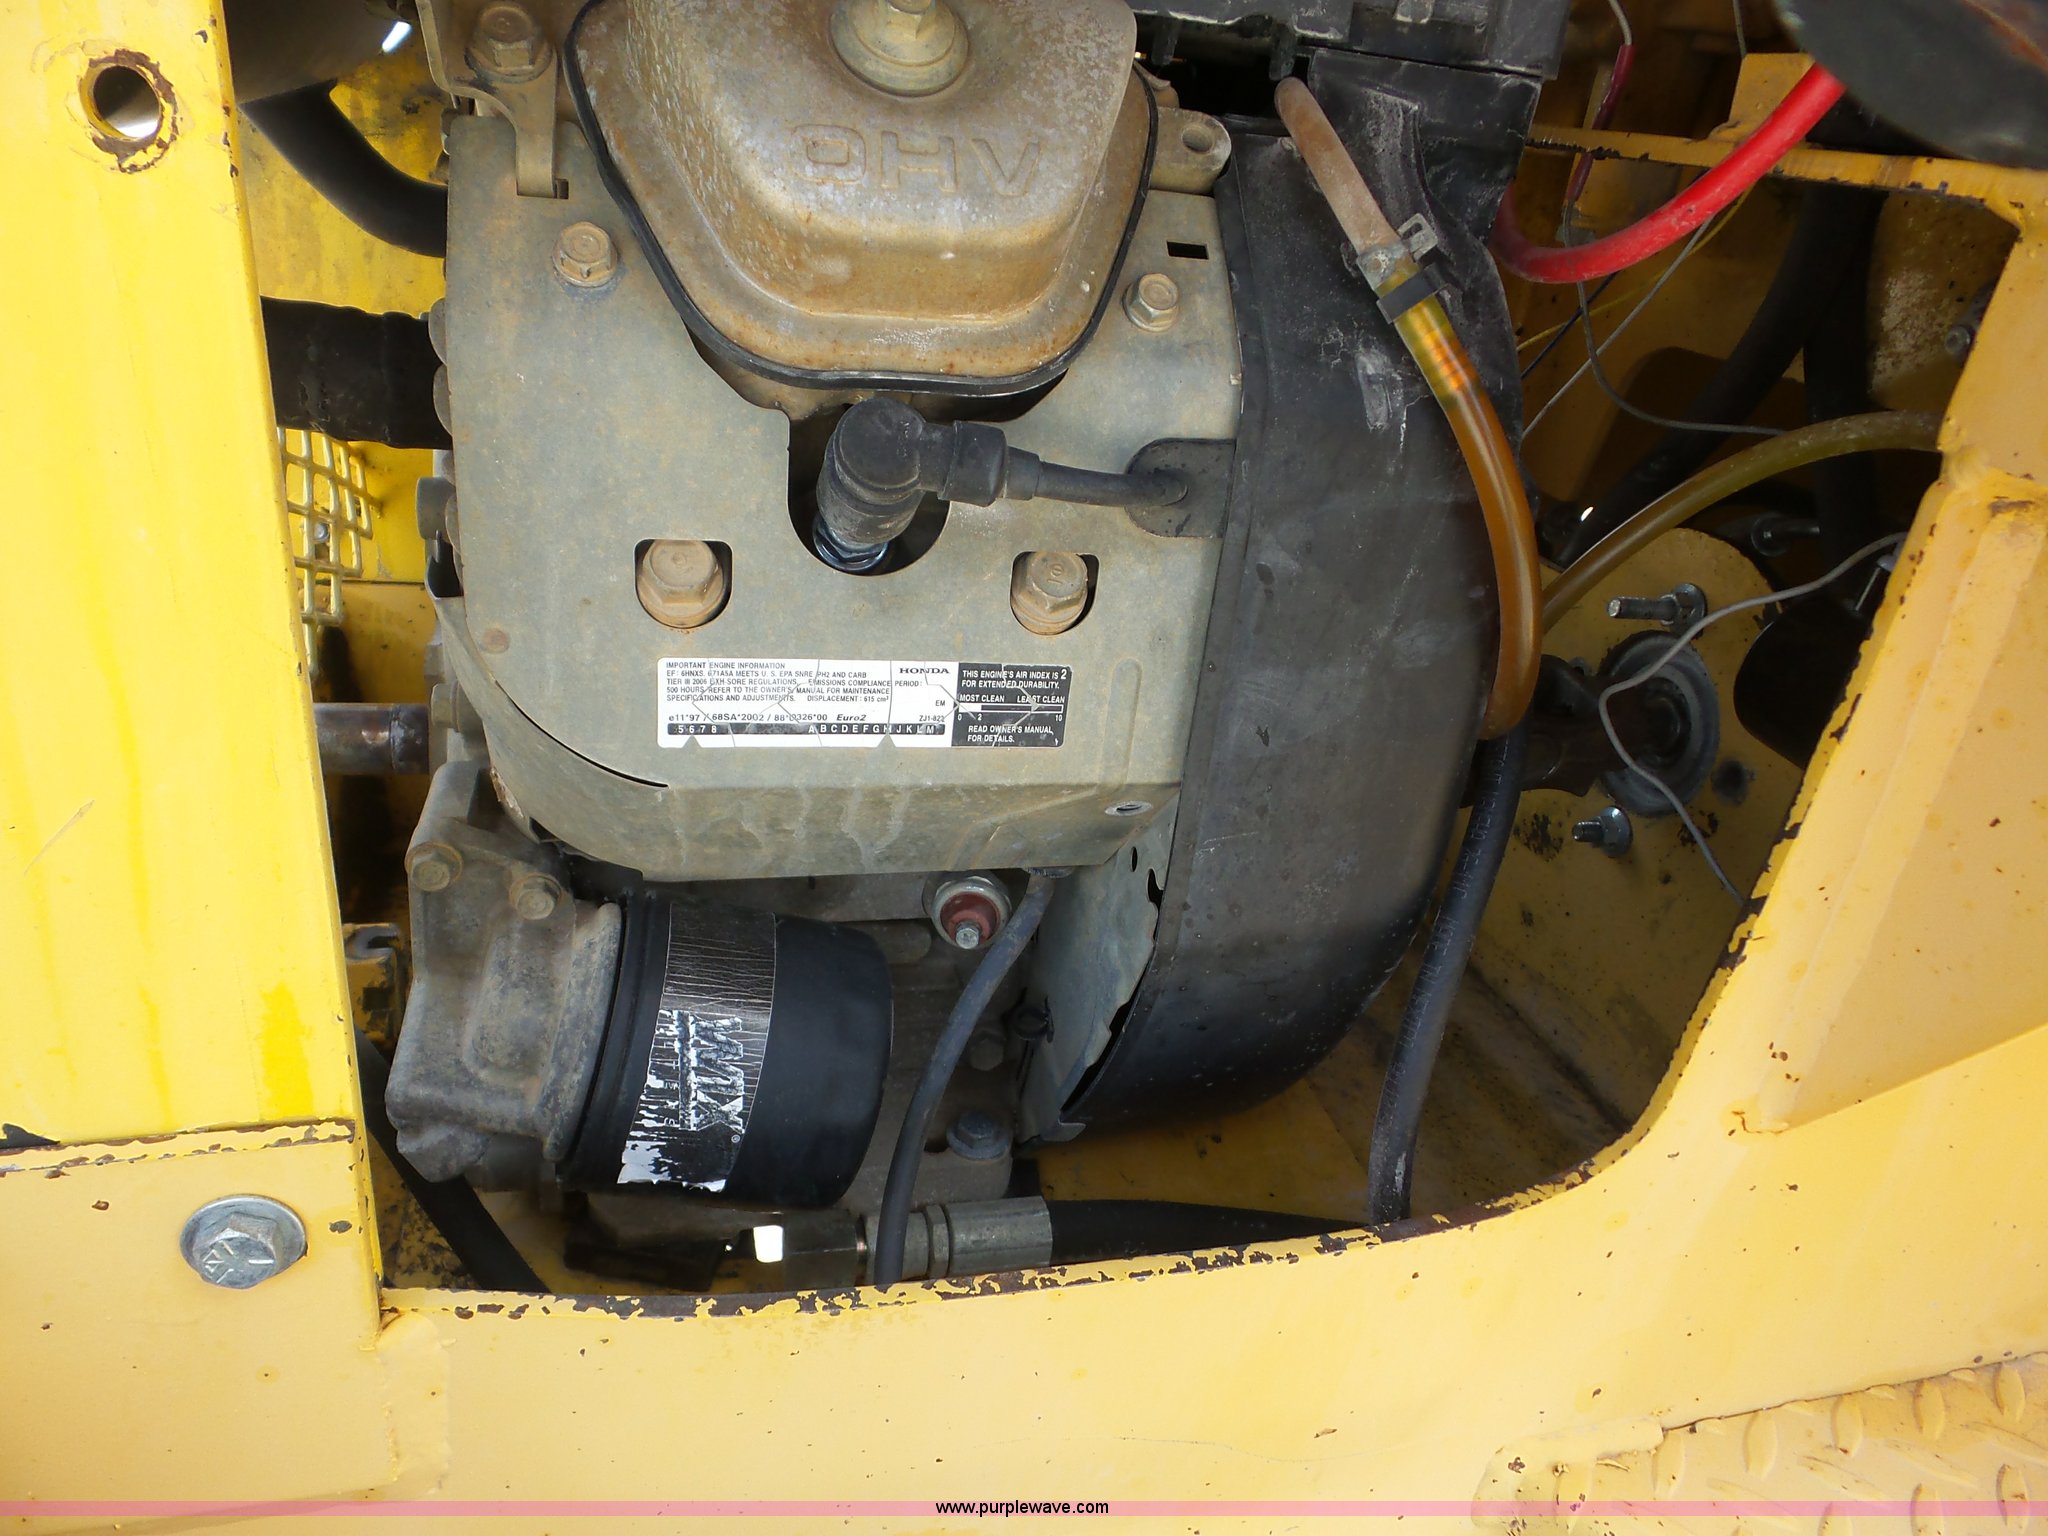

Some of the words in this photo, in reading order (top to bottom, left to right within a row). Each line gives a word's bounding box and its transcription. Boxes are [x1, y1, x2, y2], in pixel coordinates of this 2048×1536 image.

[789, 124, 1041, 197] OHV
[962, 670, 978, 678] THIS
[980, 670, 1013, 678] ENGINE'S
[1015, 671, 1027, 679] AIR
[1029, 671, 1050, 679] INDEX
[1060, 669, 1067, 680] 2
[978, 680, 1017, 688] EXTENDED
[1019, 681, 1060, 689] DURABILITY.
[960, 694, 979, 702] MOST
[978, 713, 982, 721] 2
[1055, 714, 1063, 722] 10
[678, 725, 684, 733] 5
[689, 725, 695, 733] 6
[700, 725, 706, 733] 7
[711, 725, 717, 733] 8
[808, 725, 815, 733] A
[821, 725, 827, 733] B
[830, 725, 837, 733] C
[842, 725, 848, 733] D
[852, 725, 858, 733] E
[863, 725, 869, 733] F
[873, 725, 880, 733] G
[896, 725, 902, 733] J
[906, 725, 913, 733] K
[926, 725, 934, 733] M
[989, 725, 1022, 733] OWNER'S
[1024, 726, 1053, 734] MANUAL
[984, 735, 1015, 743] DETAILS.
[689, 1016, 746, 1134] WIX
